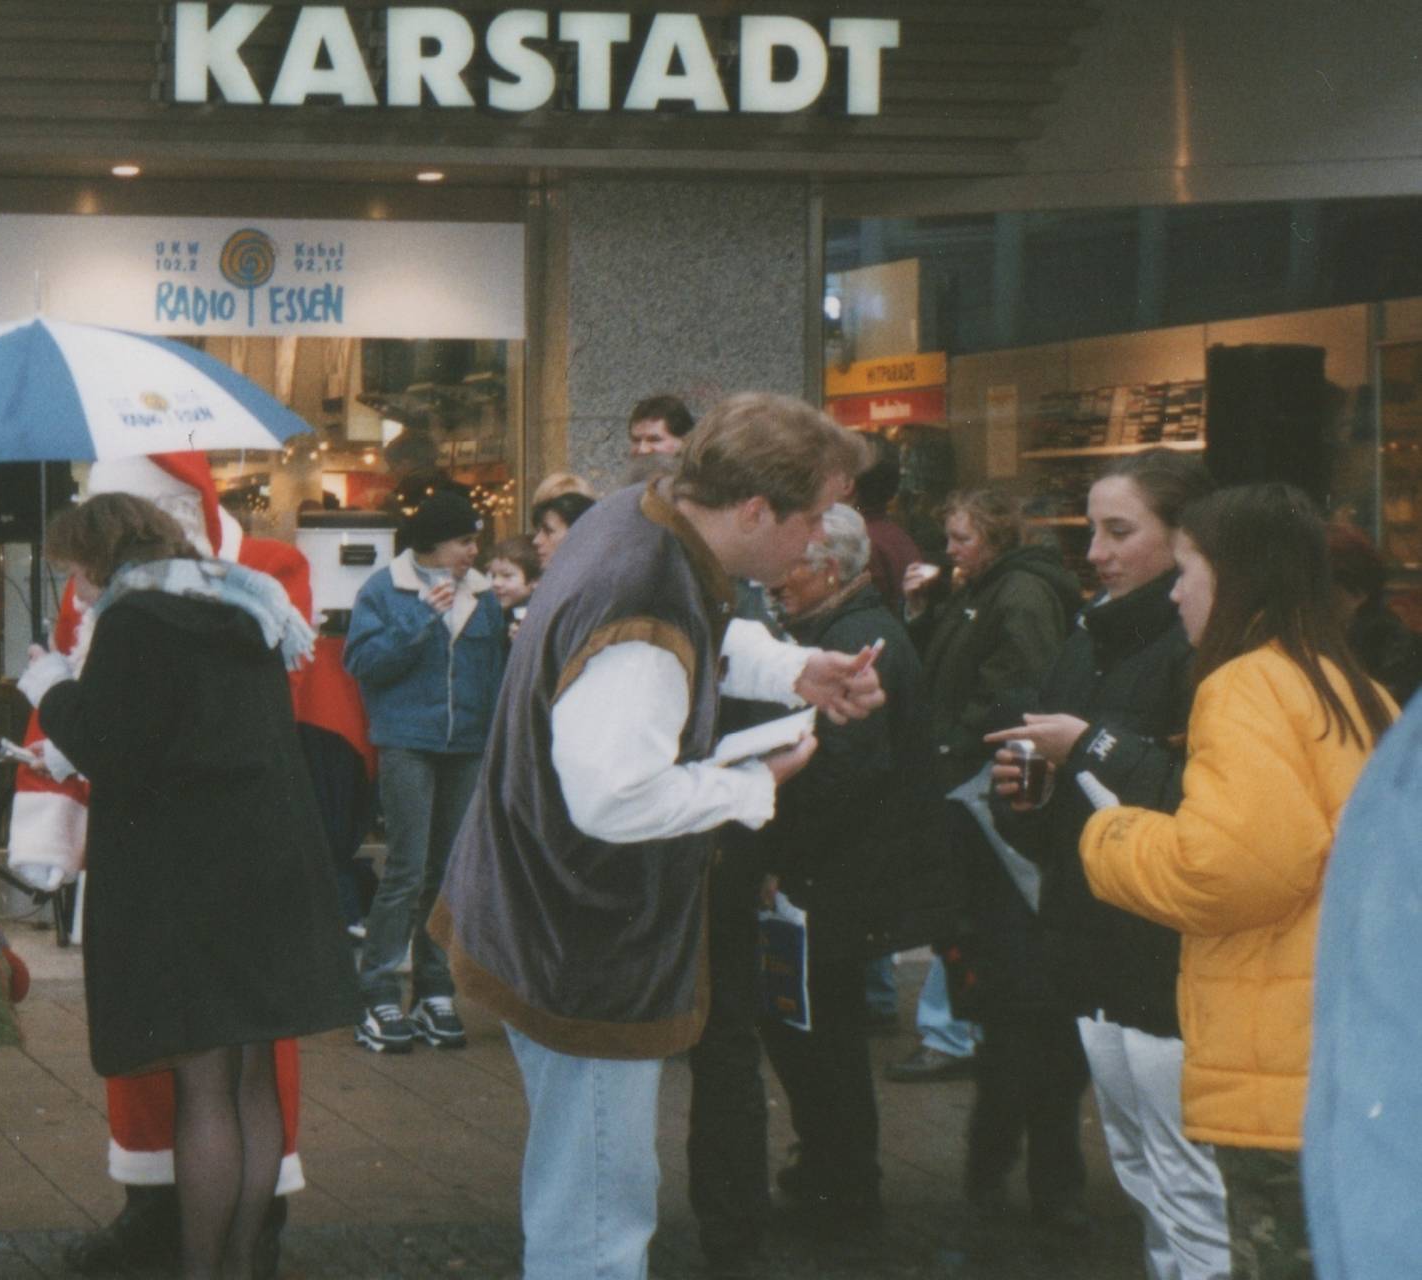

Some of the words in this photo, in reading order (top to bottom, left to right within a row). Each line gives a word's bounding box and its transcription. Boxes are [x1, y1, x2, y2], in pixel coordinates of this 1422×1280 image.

[175, 2, 899, 116] KARSTADT
[155, 281, 236, 326] RADIO
[268, 282, 344, 324] ESSEN
